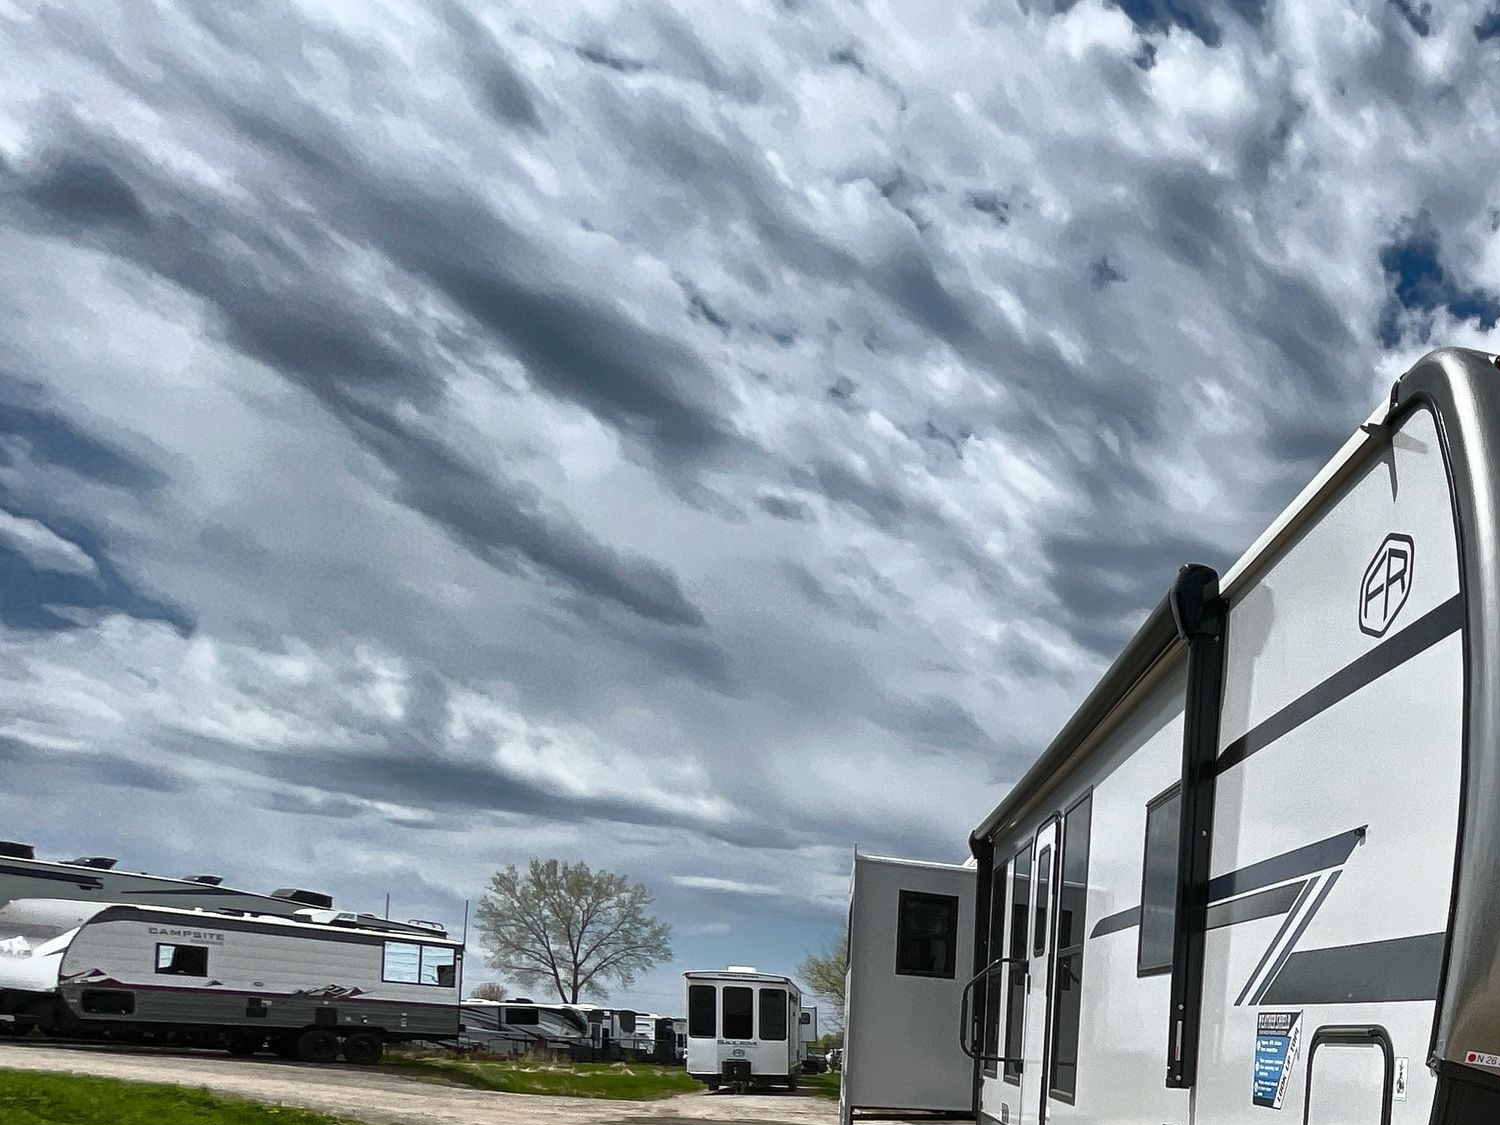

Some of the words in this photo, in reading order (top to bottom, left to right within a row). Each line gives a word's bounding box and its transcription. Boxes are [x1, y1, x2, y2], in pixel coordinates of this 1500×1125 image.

[148, 927, 225, 941] CAMPSITE
[1477, 1054, 1485, 1063] N
[1486, 1055, 1498, 1065] 26
